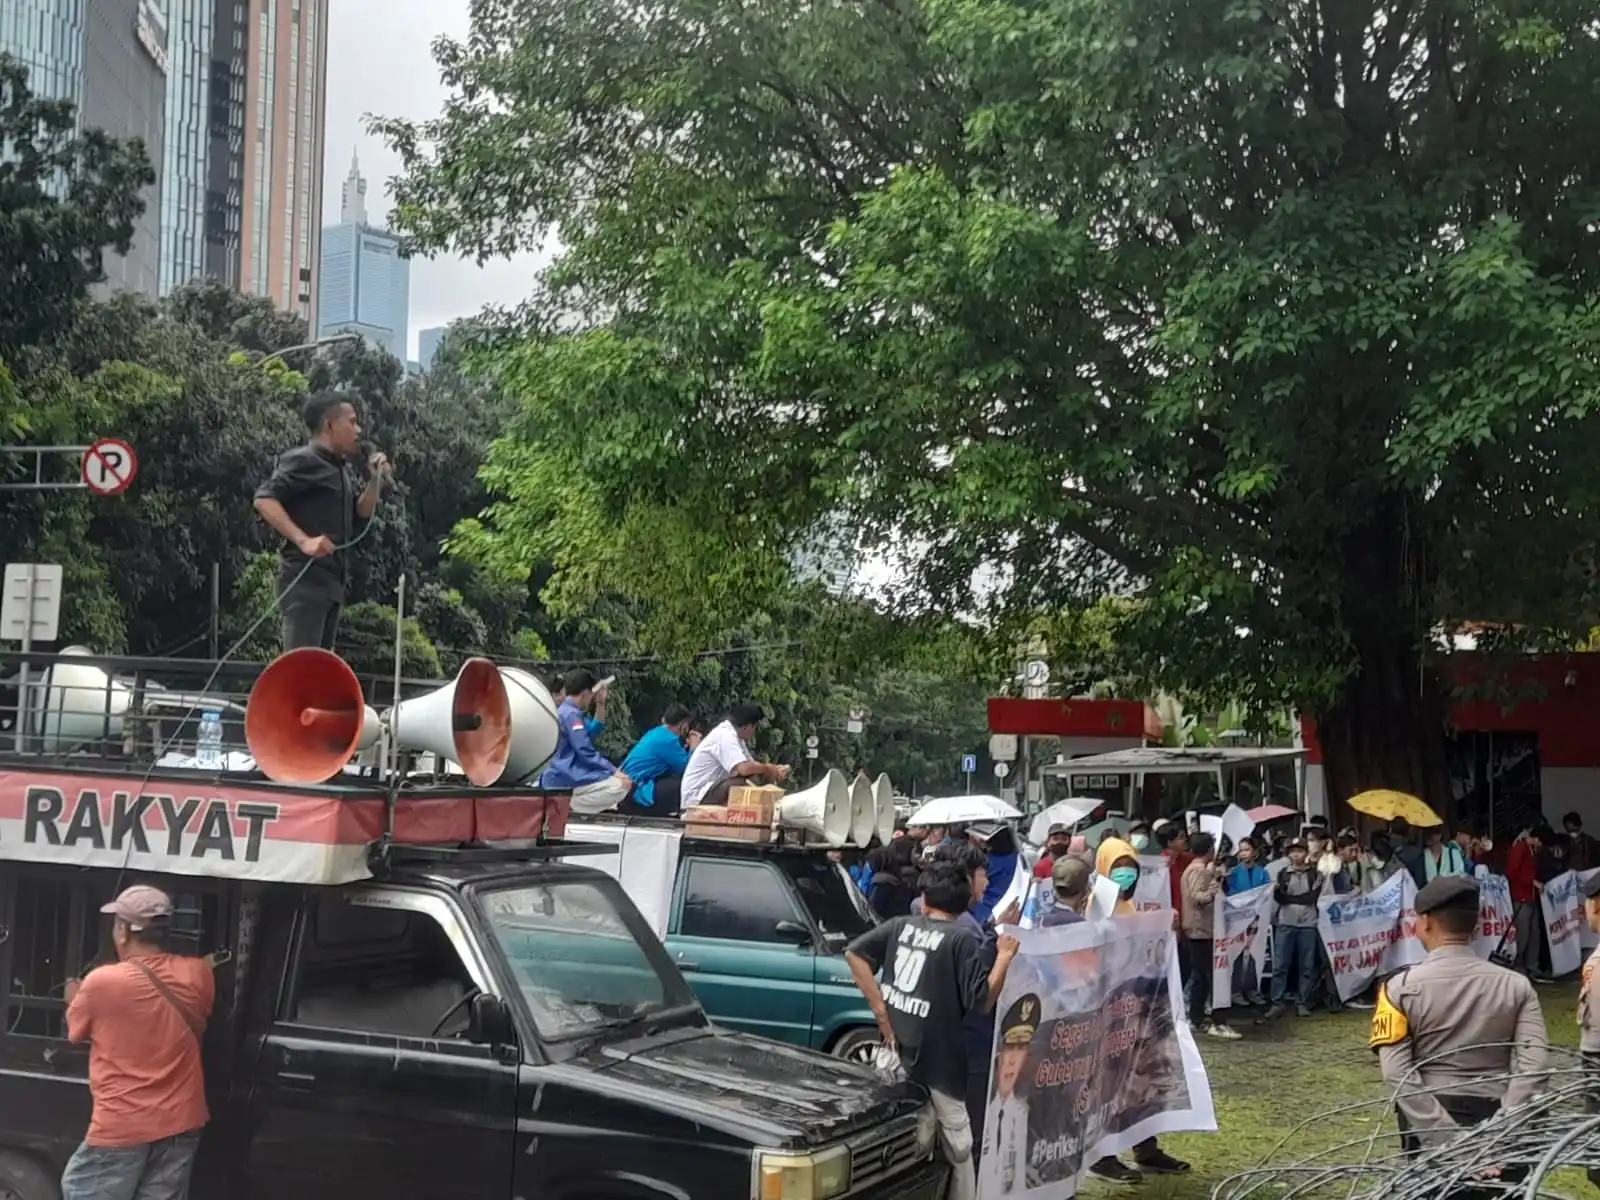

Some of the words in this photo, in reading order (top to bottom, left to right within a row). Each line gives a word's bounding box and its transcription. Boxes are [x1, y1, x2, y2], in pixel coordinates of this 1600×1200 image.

[24, 785, 281, 863] RAKYAT
[898, 923, 945, 951] RYAN
[894, 946, 927, 993] 10
